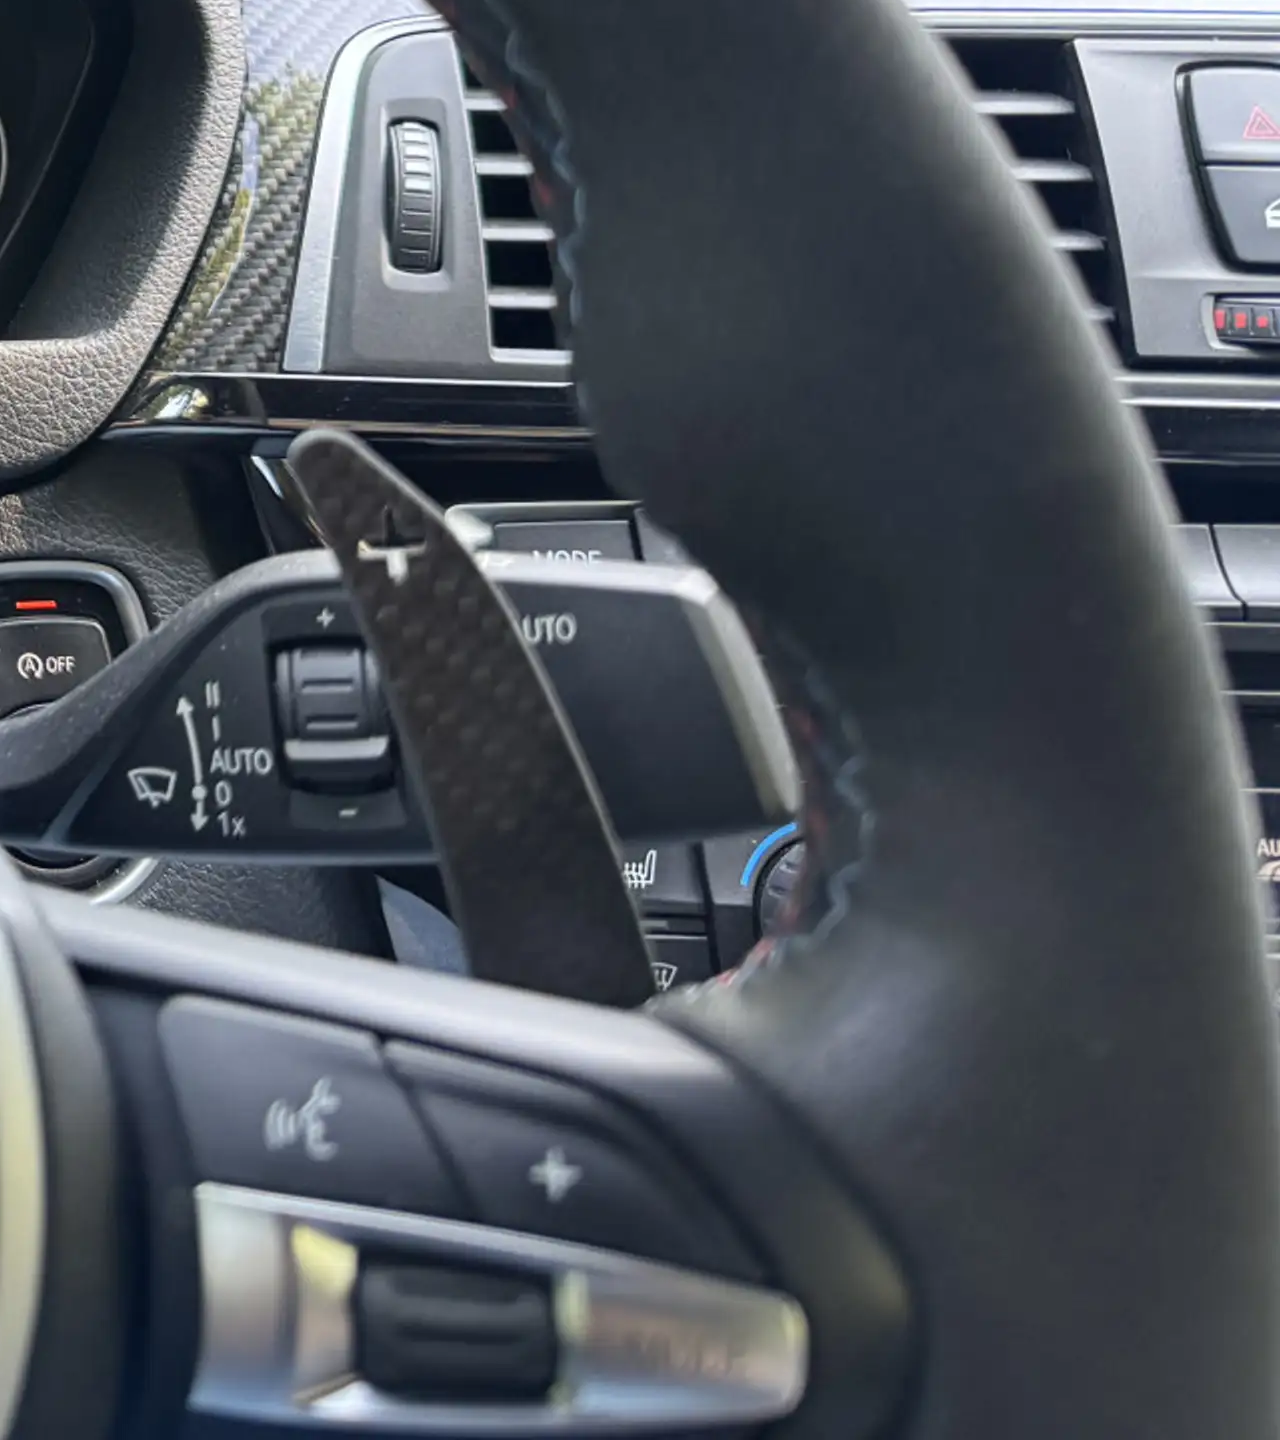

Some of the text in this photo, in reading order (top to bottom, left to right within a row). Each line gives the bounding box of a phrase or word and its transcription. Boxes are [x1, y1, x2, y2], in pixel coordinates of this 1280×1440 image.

[522, 613, 577, 645] UTO
[45, 656, 76, 674] OFF
[210, 748, 273, 774] AUTO
[215, 781, 232, 807] 0
[217, 812, 246, 837] 1x
